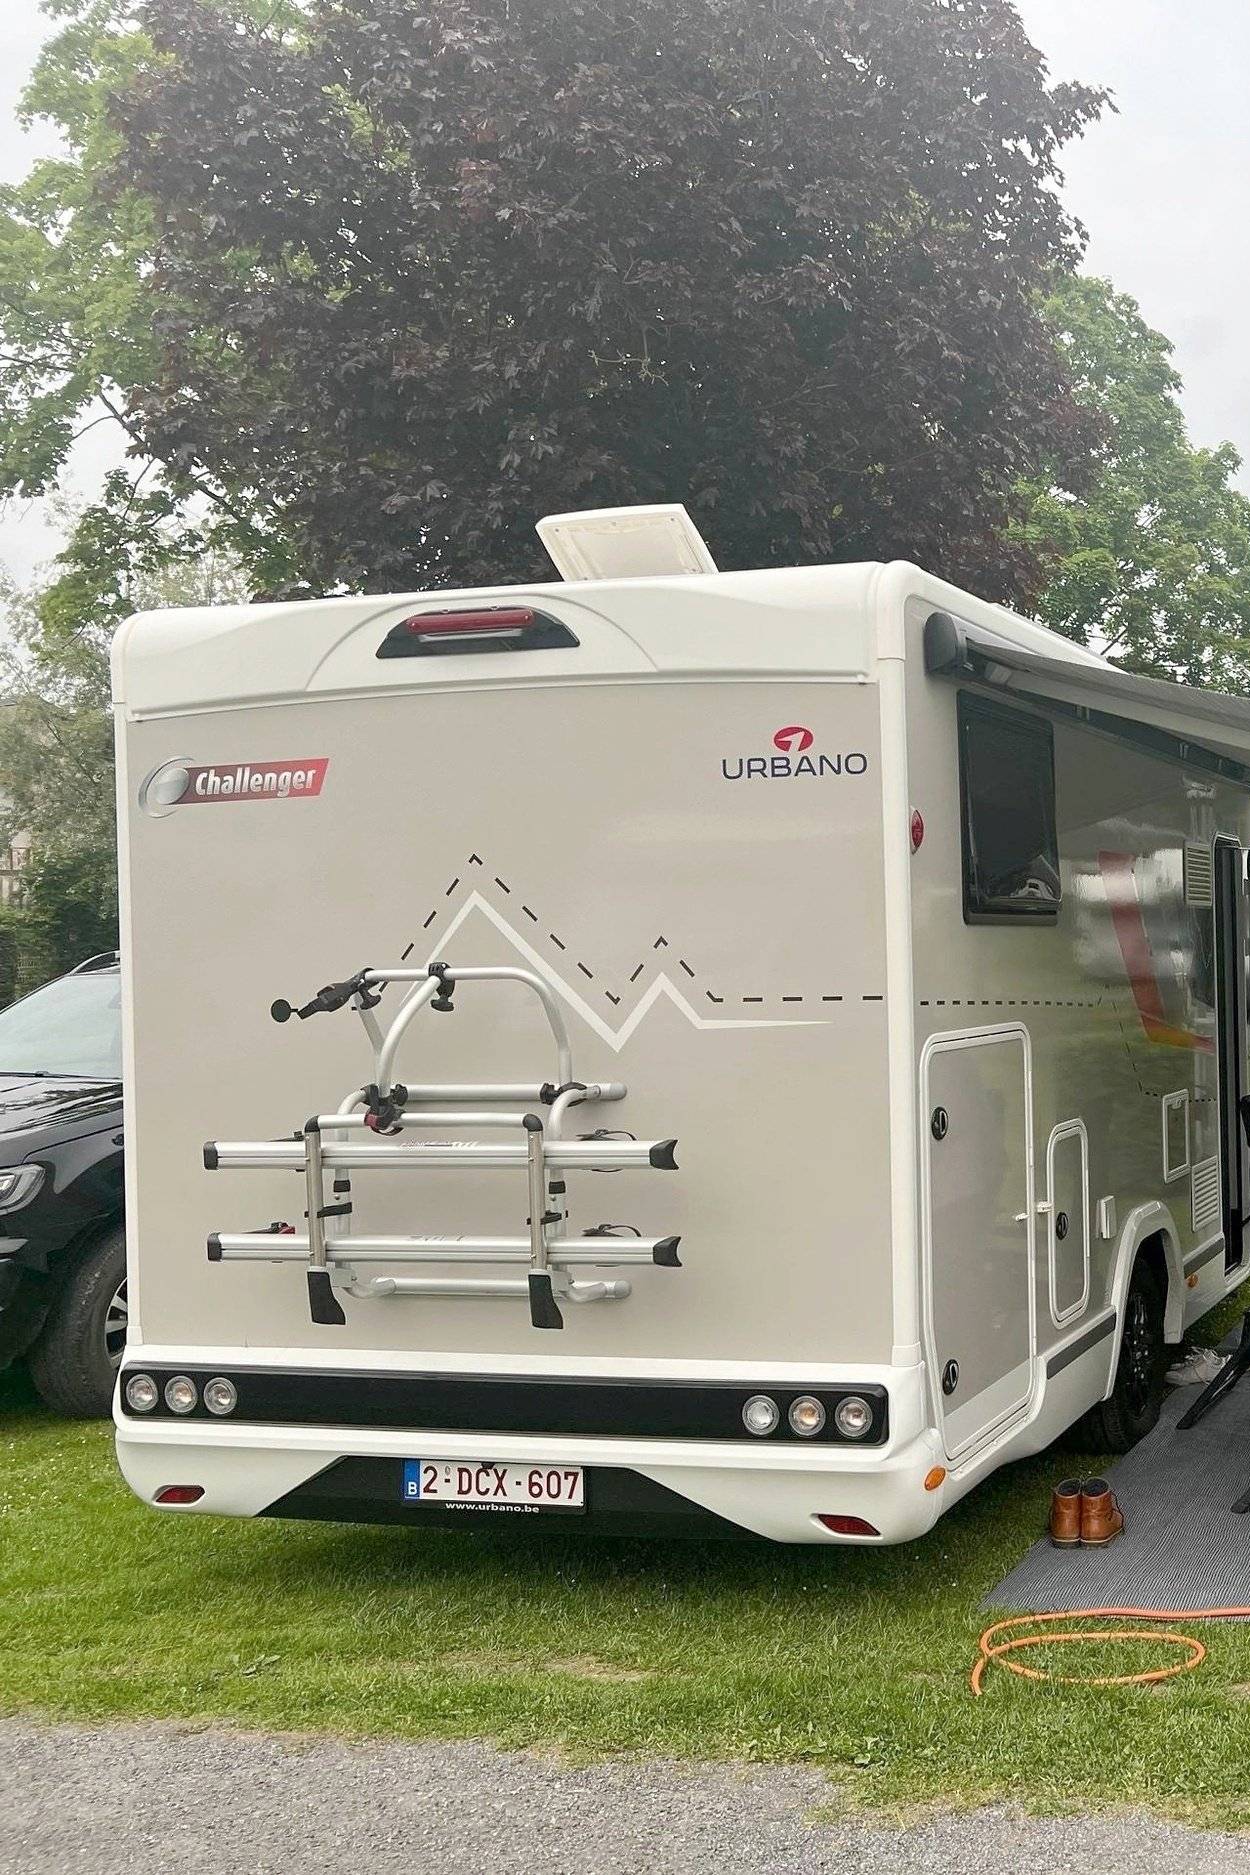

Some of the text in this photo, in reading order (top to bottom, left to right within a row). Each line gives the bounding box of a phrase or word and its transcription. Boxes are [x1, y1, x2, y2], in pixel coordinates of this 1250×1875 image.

[722, 753, 868, 780] URBANO
[195, 767, 316, 798] Challenger
[408, 1481, 418, 1495] B
[445, 1502, 540, 1514] www.urbano.be
